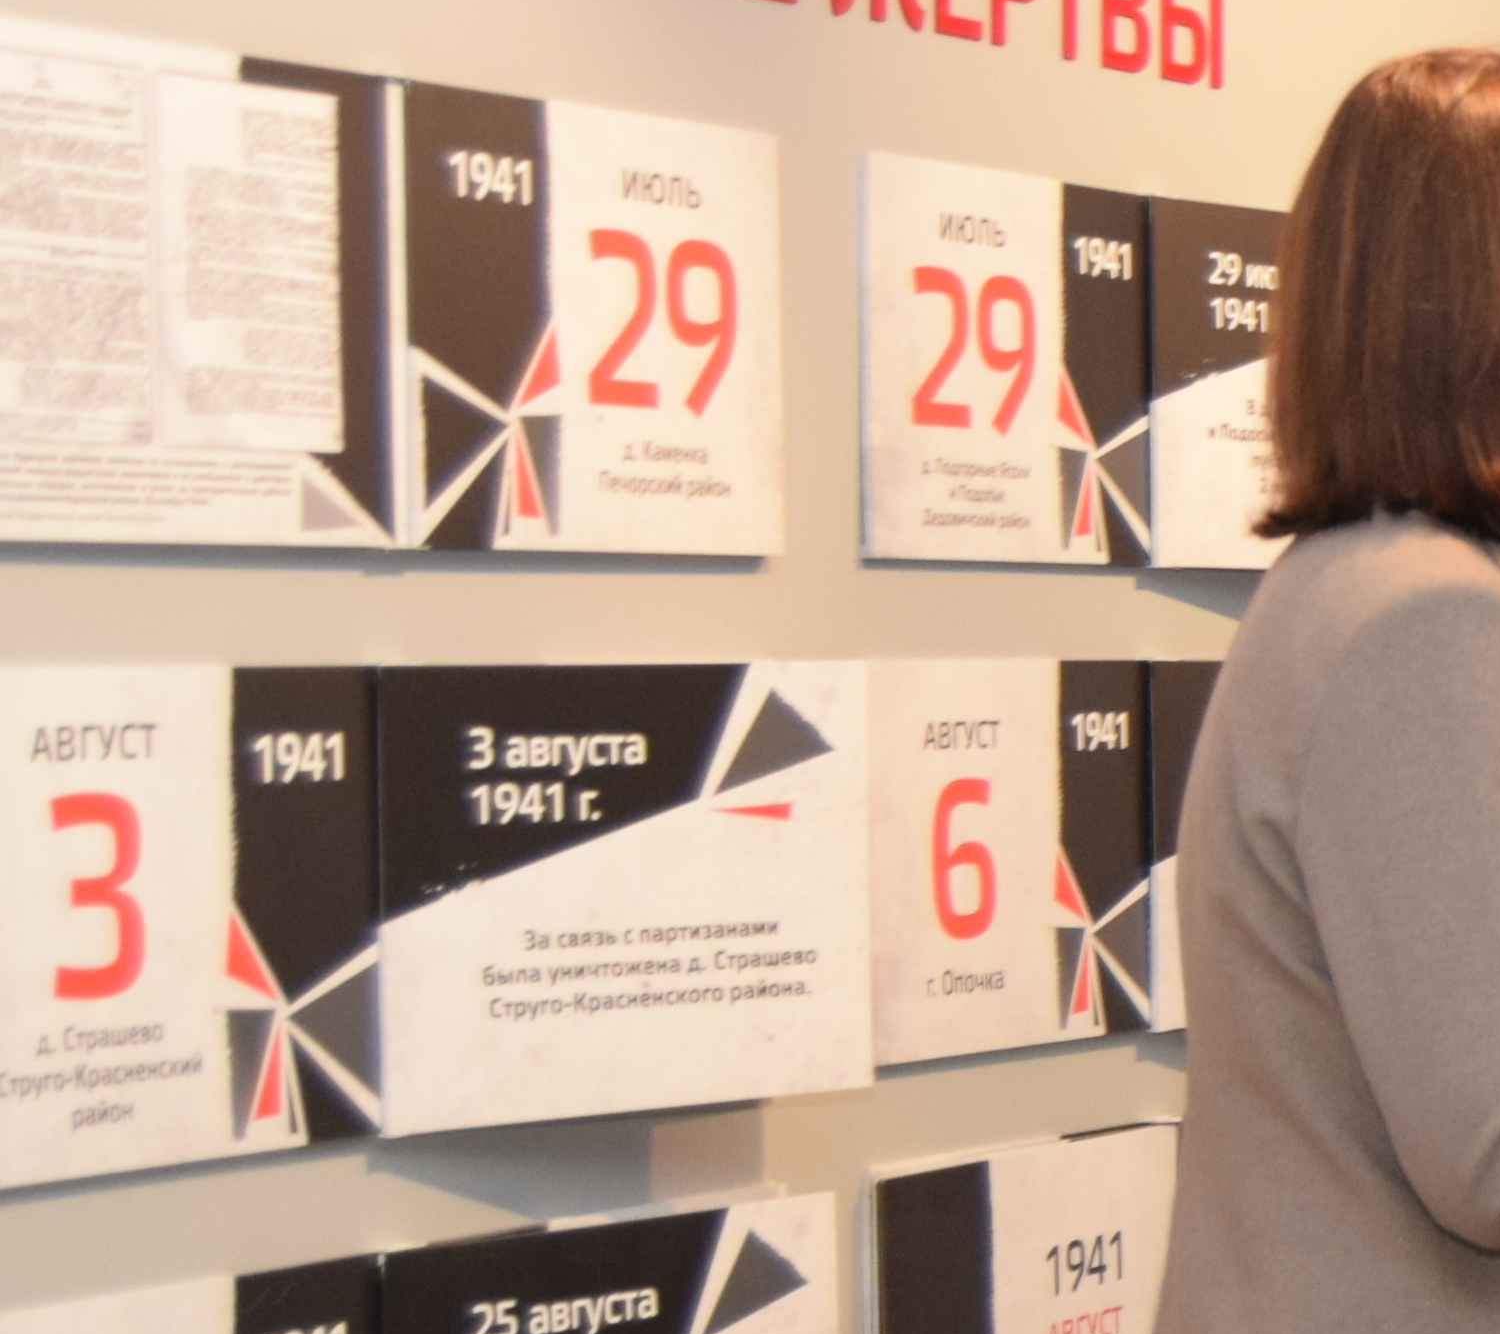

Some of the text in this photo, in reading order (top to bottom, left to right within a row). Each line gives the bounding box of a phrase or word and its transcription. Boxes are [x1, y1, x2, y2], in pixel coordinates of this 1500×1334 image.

[448, 151, 533, 205] 1941
[622, 168, 702, 209] ИЮЛЬ
[939, 211, 1006, 248] ИЮЛЬ
[1073, 236, 1133, 281] 1941
[1208, 252, 1240, 287] 29
[587, 228, 739, 418] 29
[912, 266, 1037, 437] 29
[643, 439, 709, 466] Каменка
[31, 723, 158, 763] АВГУСТ
[467, 726, 648, 776] 3 августа
[922, 720, 1000, 751] АВГУСТ
[1071, 711, 1129, 751] 1941
[253, 731, 346, 784] 1941
[470, 782, 602, 825] 1941 г.
[931, 777, 996, 940] 6
[49, 791, 146, 1001] 3
[489, 979, 812, 1021] Струго-Красненского района.
[927, 970, 1006, 998] г. Опочка
[36, 1023, 164, 1057] д. Страшево
[71, 1100, 134, 1133] район
[1046, 1230, 1123, 1297] 1941
